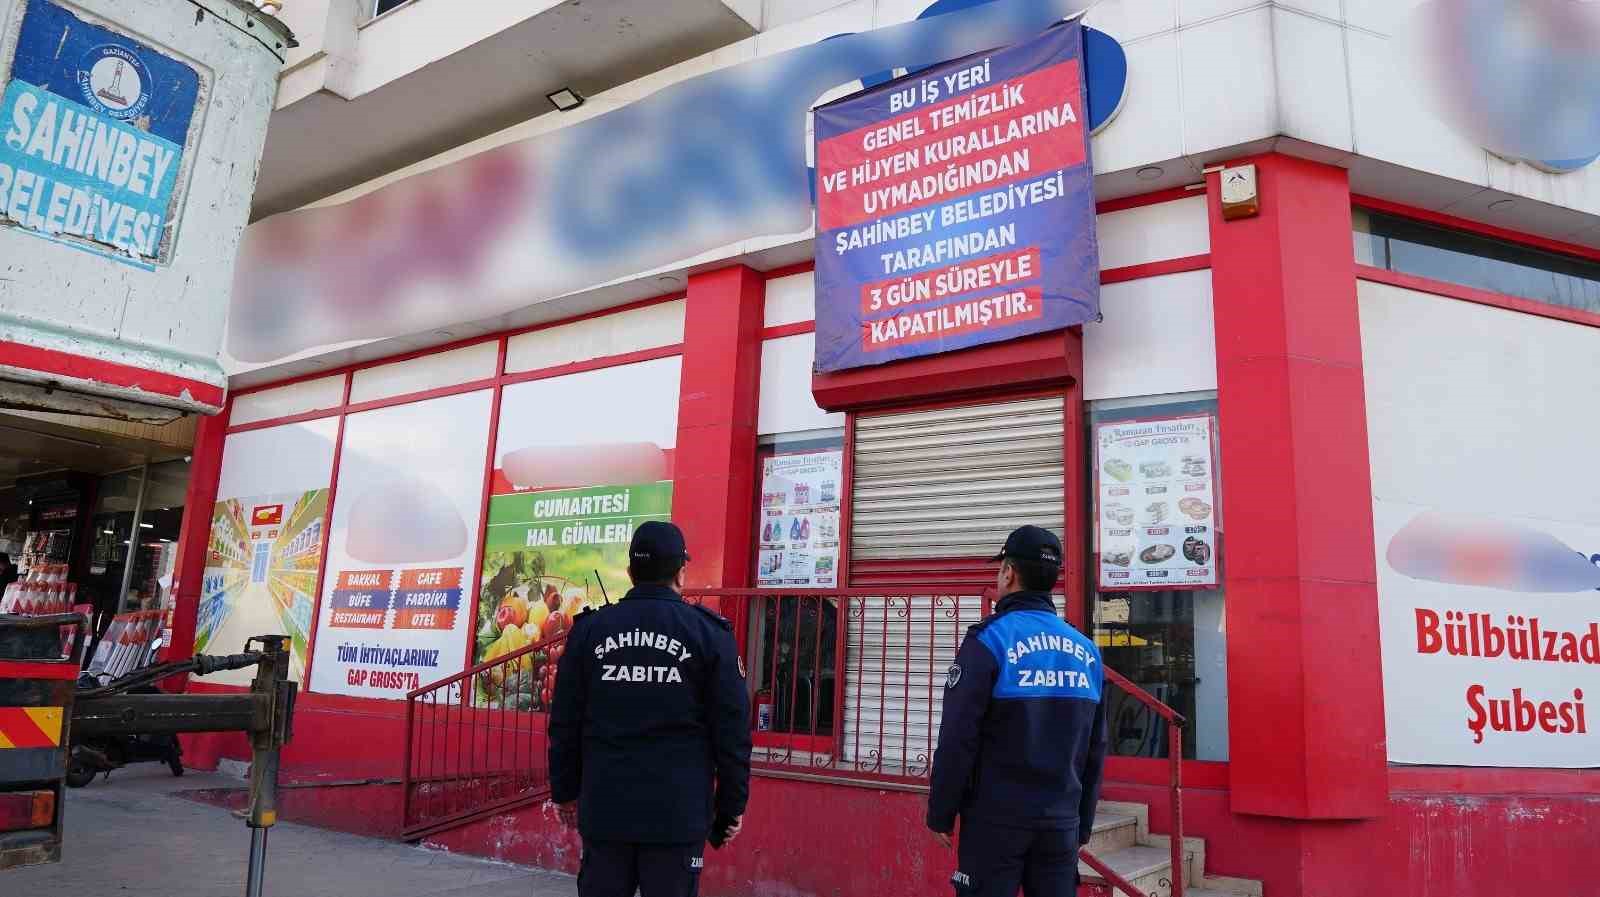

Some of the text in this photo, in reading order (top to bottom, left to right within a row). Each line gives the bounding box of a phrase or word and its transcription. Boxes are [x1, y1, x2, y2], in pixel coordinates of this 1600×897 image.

[890, 58, 991, 113] BU İŞ YERİ
[863, 84, 1025, 151] GENEL TEMİZLİK
[5, 92, 174, 199] ŞAHİNBEY
[823, 102, 1076, 193] VE HİJYEN KURALLARINA
[863, 149, 1029, 214] UYMADIĞINDAN
[836, 170, 1065, 256] ŞAHİNBEY BELEDİYESİ
[881, 224, 1016, 274] TARAFINDAN
[870, 255, 1032, 310] 3 GÜN SÜREYLE
[871, 291, 1033, 343] KAPATILMIŞTIR.
[534, 489, 630, 518] CUMARTESİ
[526, 518, 633, 547] HAL GÜNLERİ
[348, 573, 381, 586] BAKKAL
[418, 572, 442, 585] CAFE
[349, 592, 372, 607] BÜFE
[406, 590, 447, 606] FABRİKA
[334, 612, 382, 625] RESTAURANT
[411, 613, 436, 626] OTEL
[594, 628, 692, 662] ŞAHİNBEY
[1007, 632, 1096, 666] ŞAHİNBEY
[1415, 608, 1600, 664] Bülbülzad
[337, 642, 439, 668] TÜM İHTİYAÇLARINIZ
[347, 668, 419, 690] GAP GROSS'TA
[601, 665, 682, 683] ZABITA
[1018, 669, 1090, 689] ZABITA
[1466, 684, 1586, 744] Şubesi
